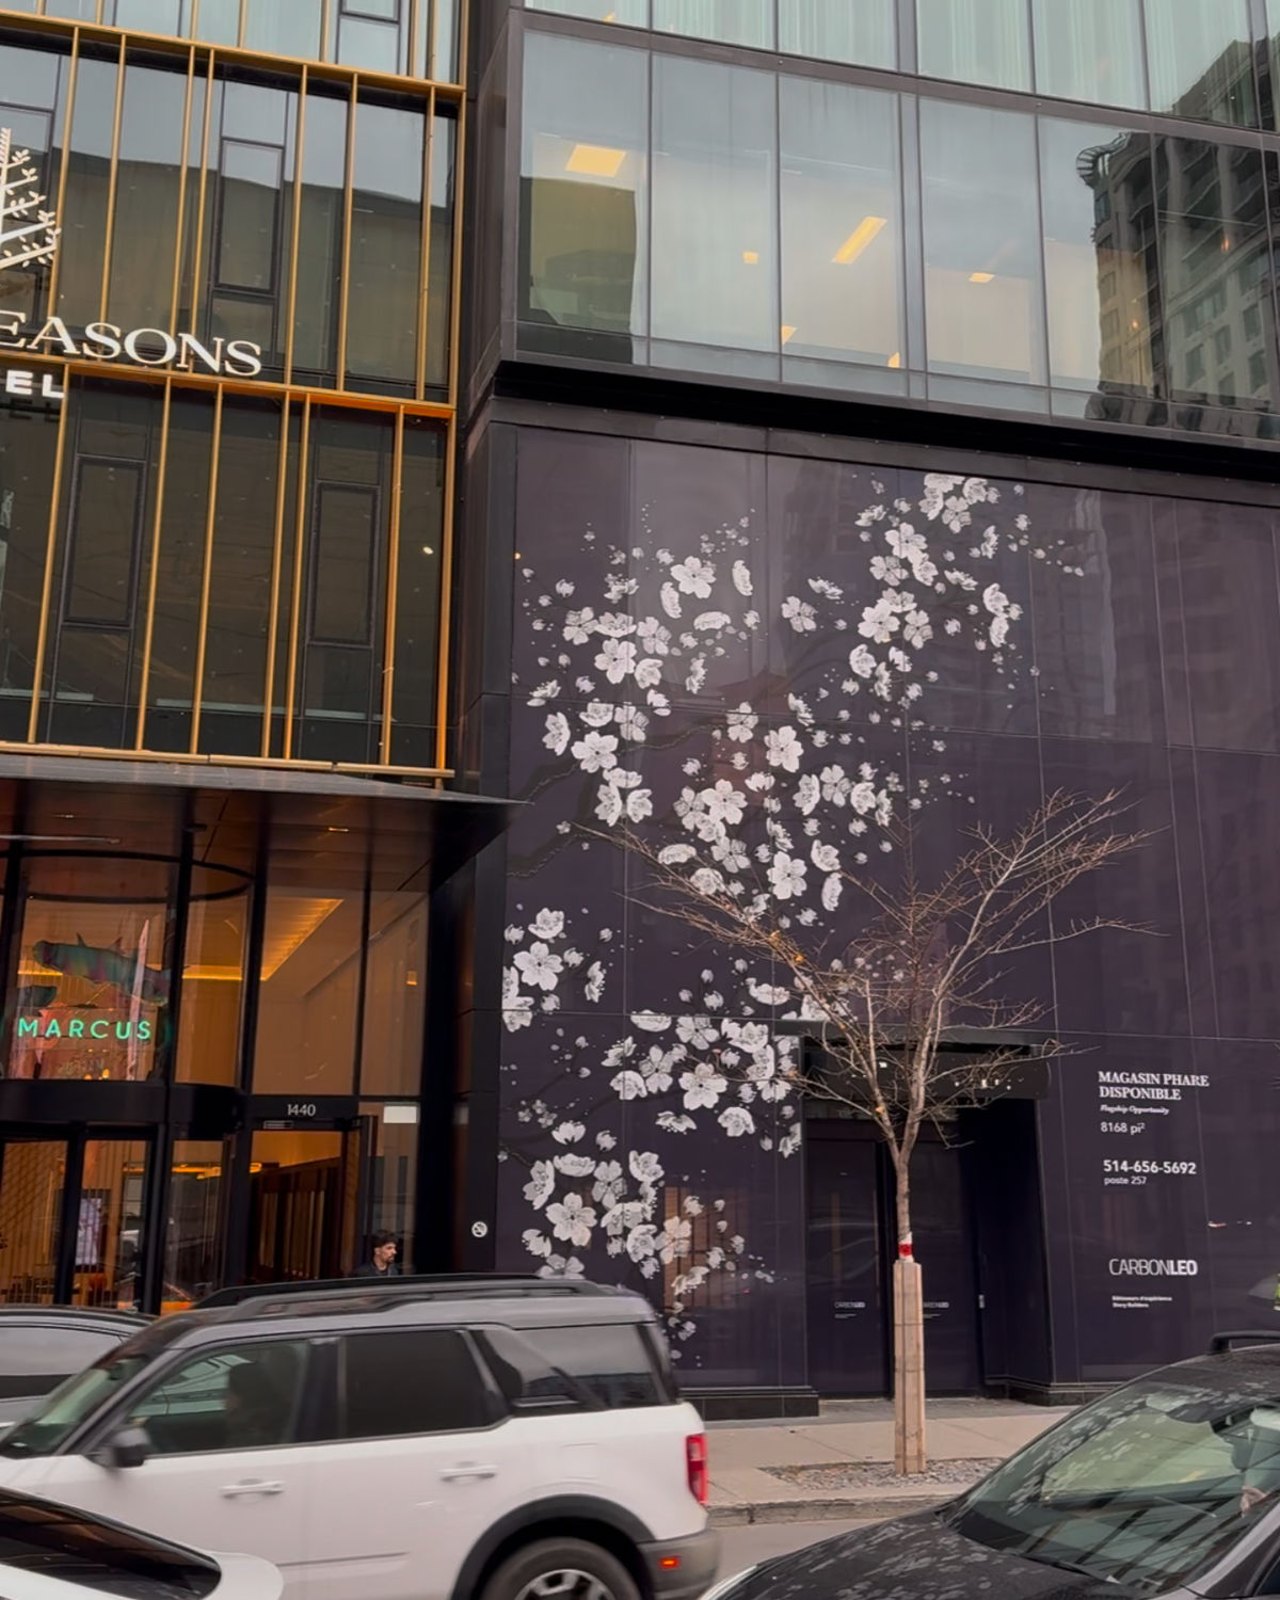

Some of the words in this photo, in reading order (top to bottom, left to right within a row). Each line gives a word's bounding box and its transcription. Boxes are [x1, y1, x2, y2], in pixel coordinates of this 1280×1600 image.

[17, 1018, 152, 1041] MARCUS
[1098, 1071, 1160, 1084] MAGASIN
[1163, 1073, 1210, 1087] PHARE
[1099, 1086, 1182, 1101] DISPONIBLE
[287, 1103, 317, 1117] 1440
[1100, 1122, 1128, 1133] 8168
[1103, 1159, 1197, 1175] 514-656-5692
[1104, 1177, 1129, 1186] poste
[1131, 1176, 1147, 1185] 257
[1109, 1258, 1199, 1276] CARBONLEO
